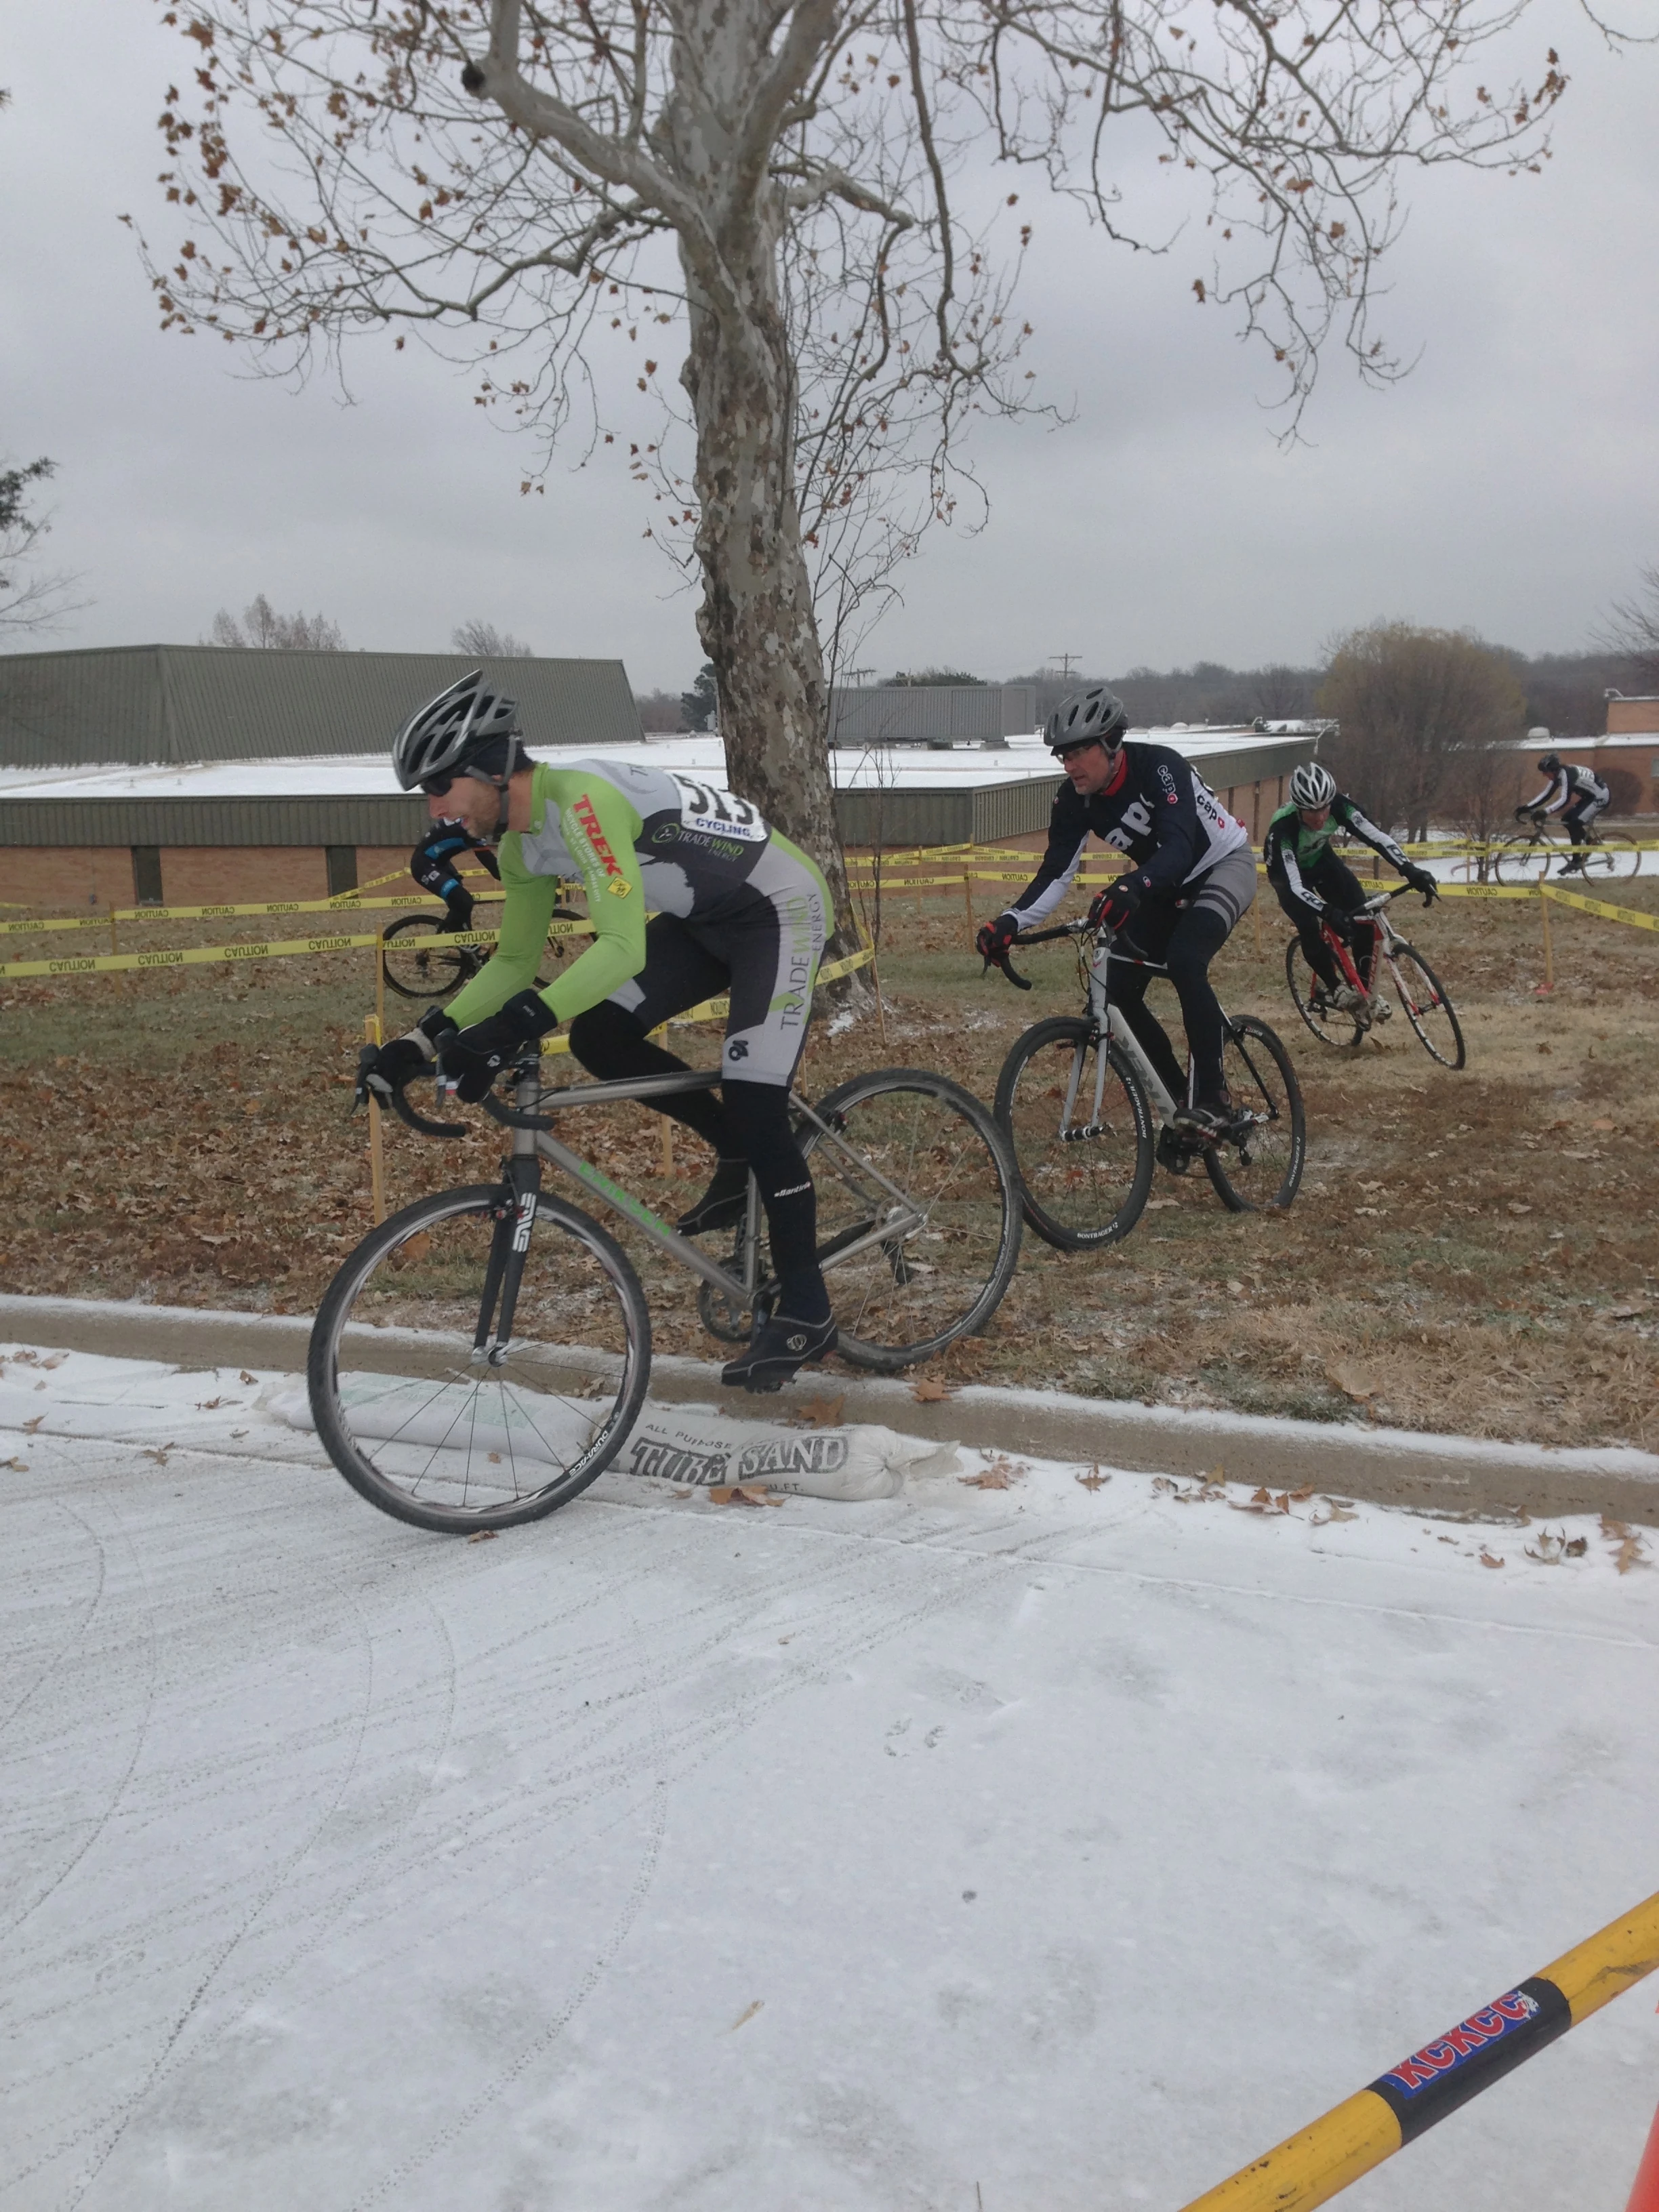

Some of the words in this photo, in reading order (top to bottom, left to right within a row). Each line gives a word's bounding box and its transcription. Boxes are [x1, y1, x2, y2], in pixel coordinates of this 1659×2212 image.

[573, 794, 623, 876] TREK
[695, 818, 751, 836] CYCLING
[1077, 1226, 1113, 1240] BONTRAGER
[645, 1424, 668, 1435] ALL
[569, 1430, 609, 1477] DURA-ACE
[739, 1436, 848, 1479] SAND
[1390, 1994, 1532, 2090] KCKCC
